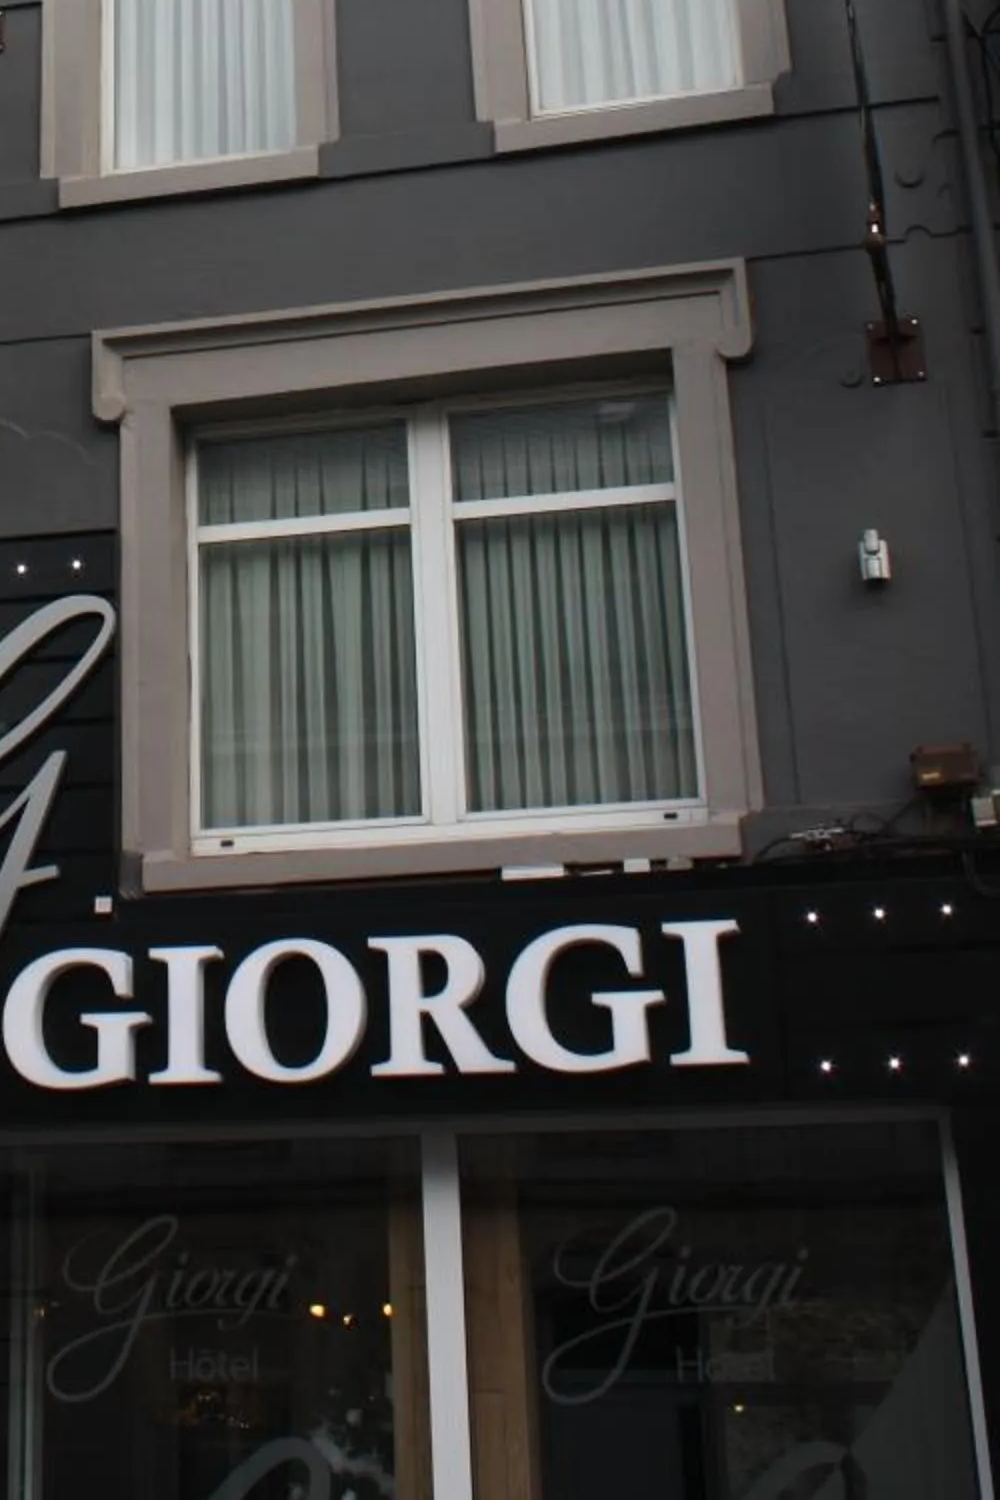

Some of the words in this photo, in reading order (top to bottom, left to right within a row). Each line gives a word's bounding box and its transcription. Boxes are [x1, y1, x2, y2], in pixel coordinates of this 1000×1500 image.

[1, 918, 751, 1090] GIORGI
[46, 1213, 298, 1403] Giorgi
[541, 1205, 812, 1406] Giorgi
